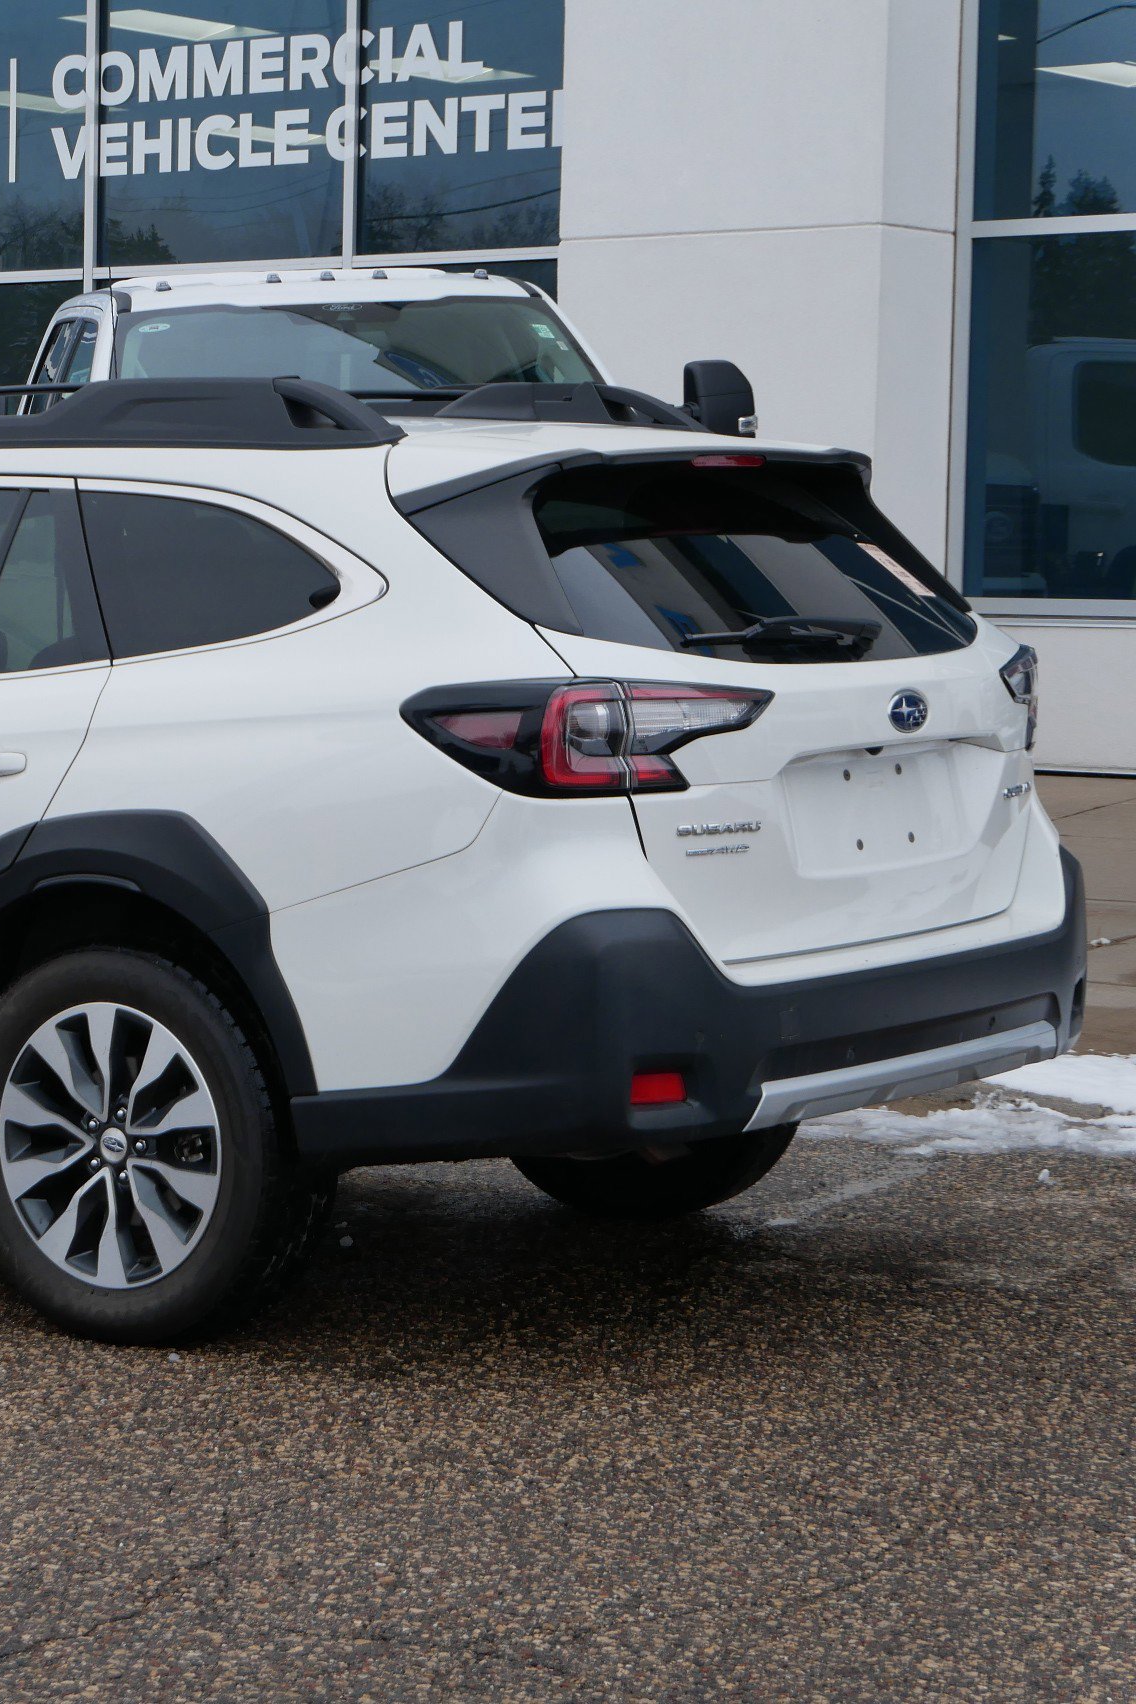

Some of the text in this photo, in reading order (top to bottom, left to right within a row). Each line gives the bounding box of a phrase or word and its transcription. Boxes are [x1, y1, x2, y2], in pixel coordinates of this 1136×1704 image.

[52, 20, 484, 109] COMMERCIAL
[51, 89, 563, 180] VEHICLE CENTE
[676, 820, 762, 837] SUBARU
